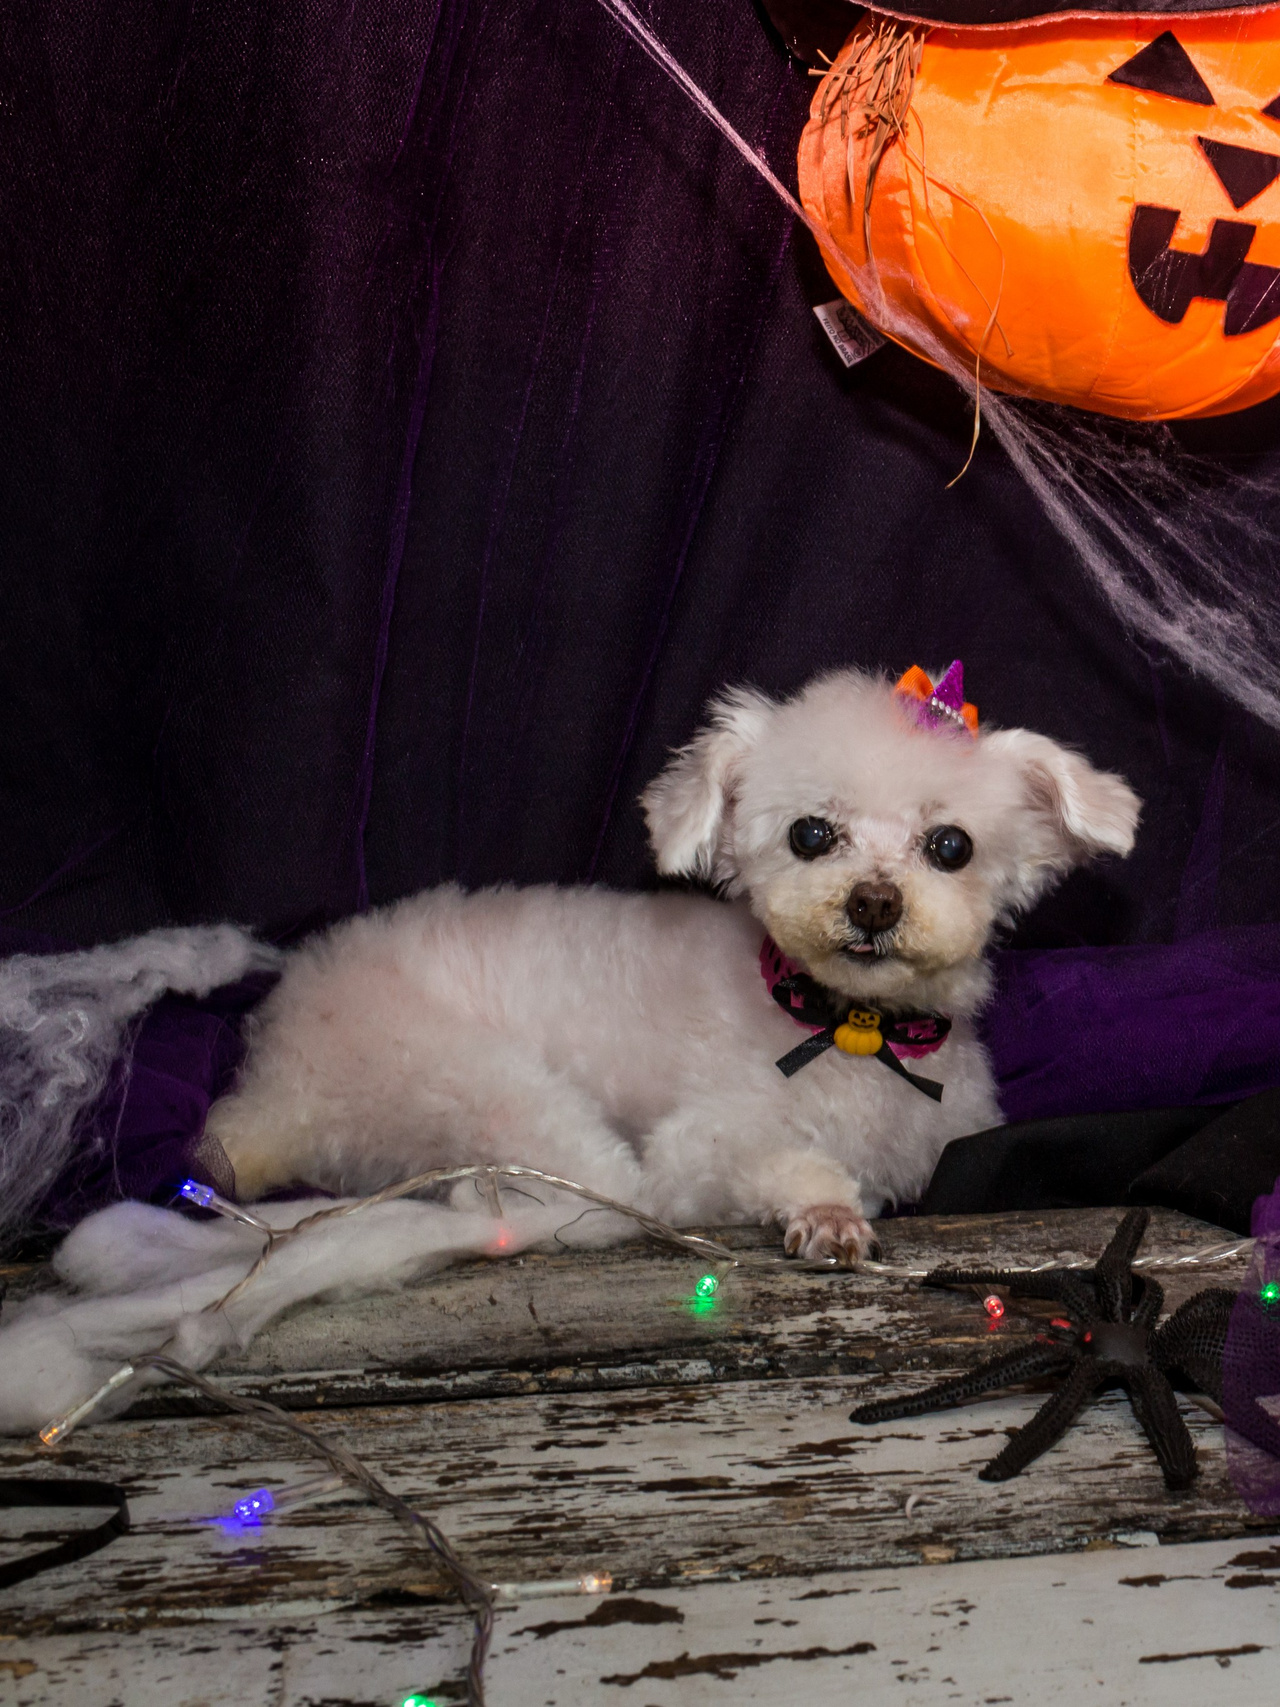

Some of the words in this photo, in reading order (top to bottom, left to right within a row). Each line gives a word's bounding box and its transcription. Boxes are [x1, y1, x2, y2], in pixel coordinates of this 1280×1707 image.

[823, 318, 835, 335] FEITO
[833, 334, 841, 344] NO
[838, 344, 853, 364] BRASIL
